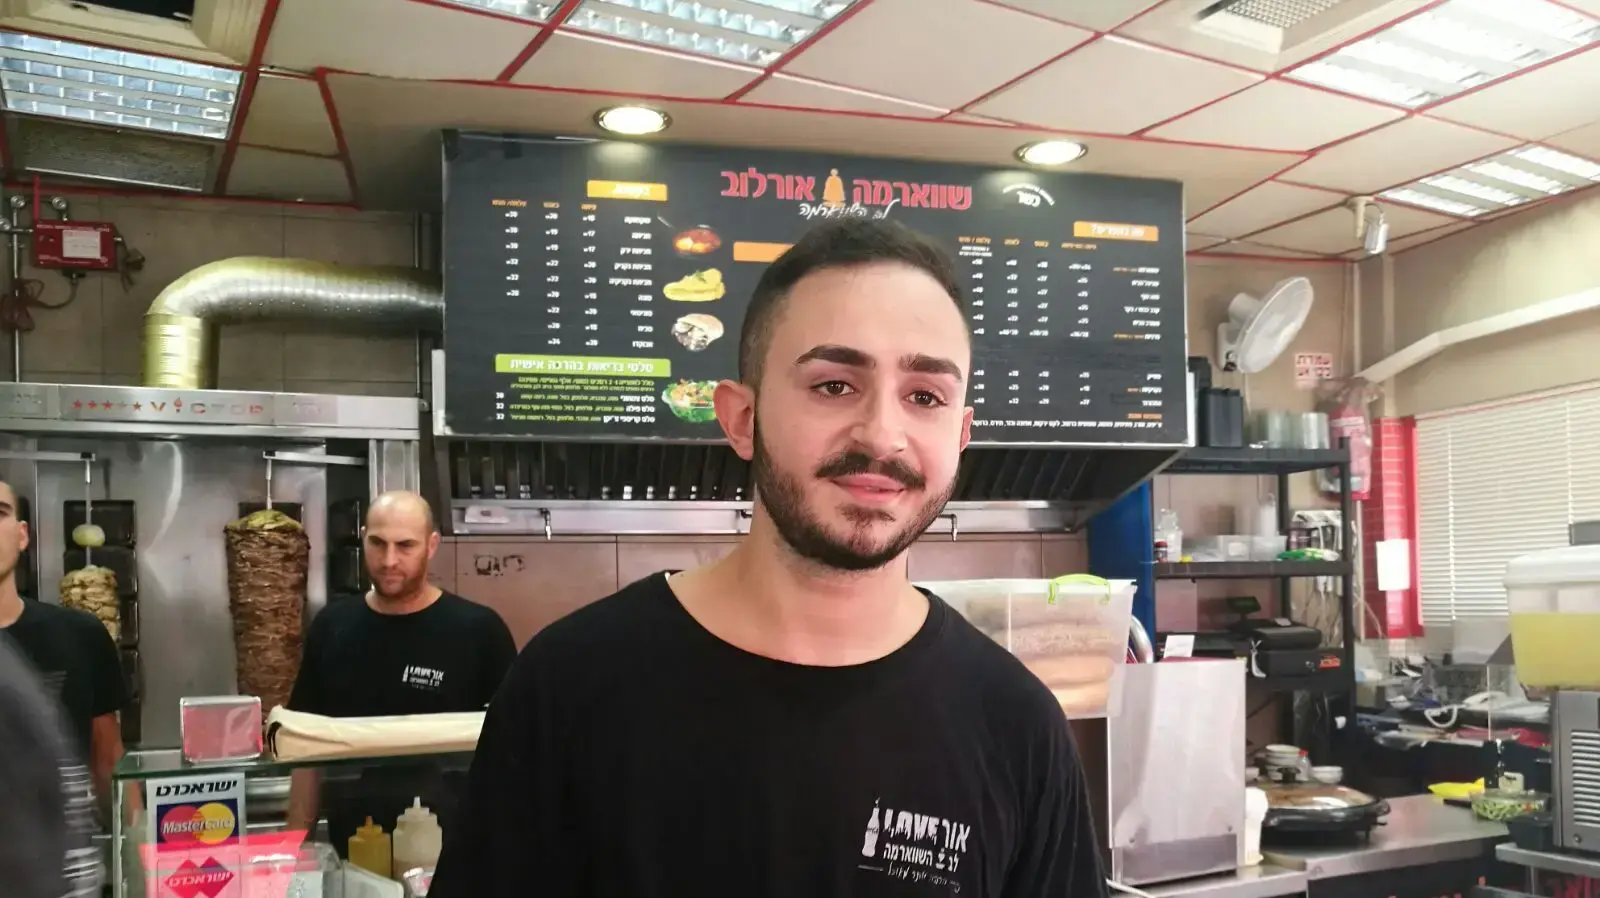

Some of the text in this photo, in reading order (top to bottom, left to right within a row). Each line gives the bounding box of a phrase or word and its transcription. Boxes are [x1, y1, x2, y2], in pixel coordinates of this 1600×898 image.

[720, 167, 816, 202] אורלוב
[852, 178, 973, 211] שווארמה
[155, 780, 238, 798] ישראכרט
[162, 816, 236, 835] MasterCard
[941, 818, 971, 853] אור
[882, 842, 934, 867] השווארמה
[168, 871, 231, 888] ישראכרט
